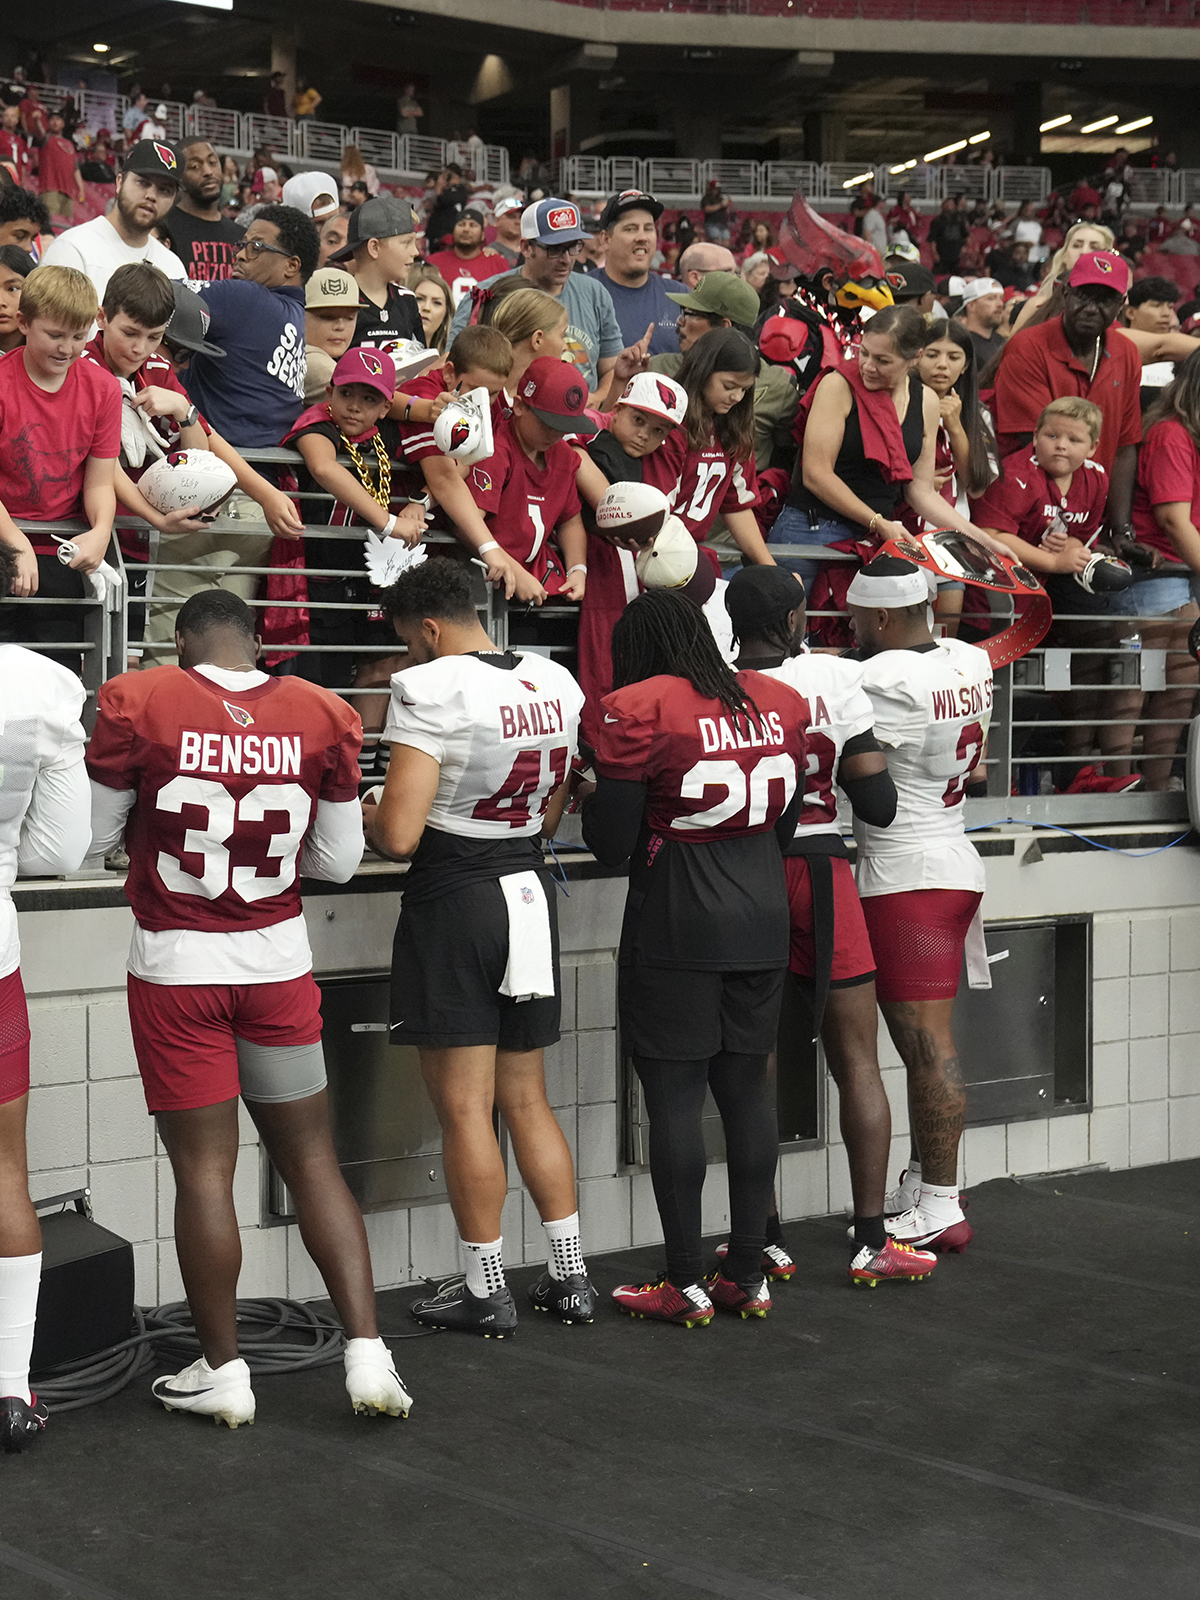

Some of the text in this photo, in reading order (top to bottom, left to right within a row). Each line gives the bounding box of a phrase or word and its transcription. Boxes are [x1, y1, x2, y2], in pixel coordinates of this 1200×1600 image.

[687, 462, 727, 521] 10
[525, 504, 545, 562] 1
[500, 699, 563, 739] BAILEY
[932, 683, 983, 720] WILSON
[179, 731, 301, 775] BENSON
[699, 711, 785, 753] DALLAS
[471, 746, 569, 829] 41
[670, 752, 797, 830] 20
[941, 721, 984, 808] 2
[156, 775, 312, 903] 33
